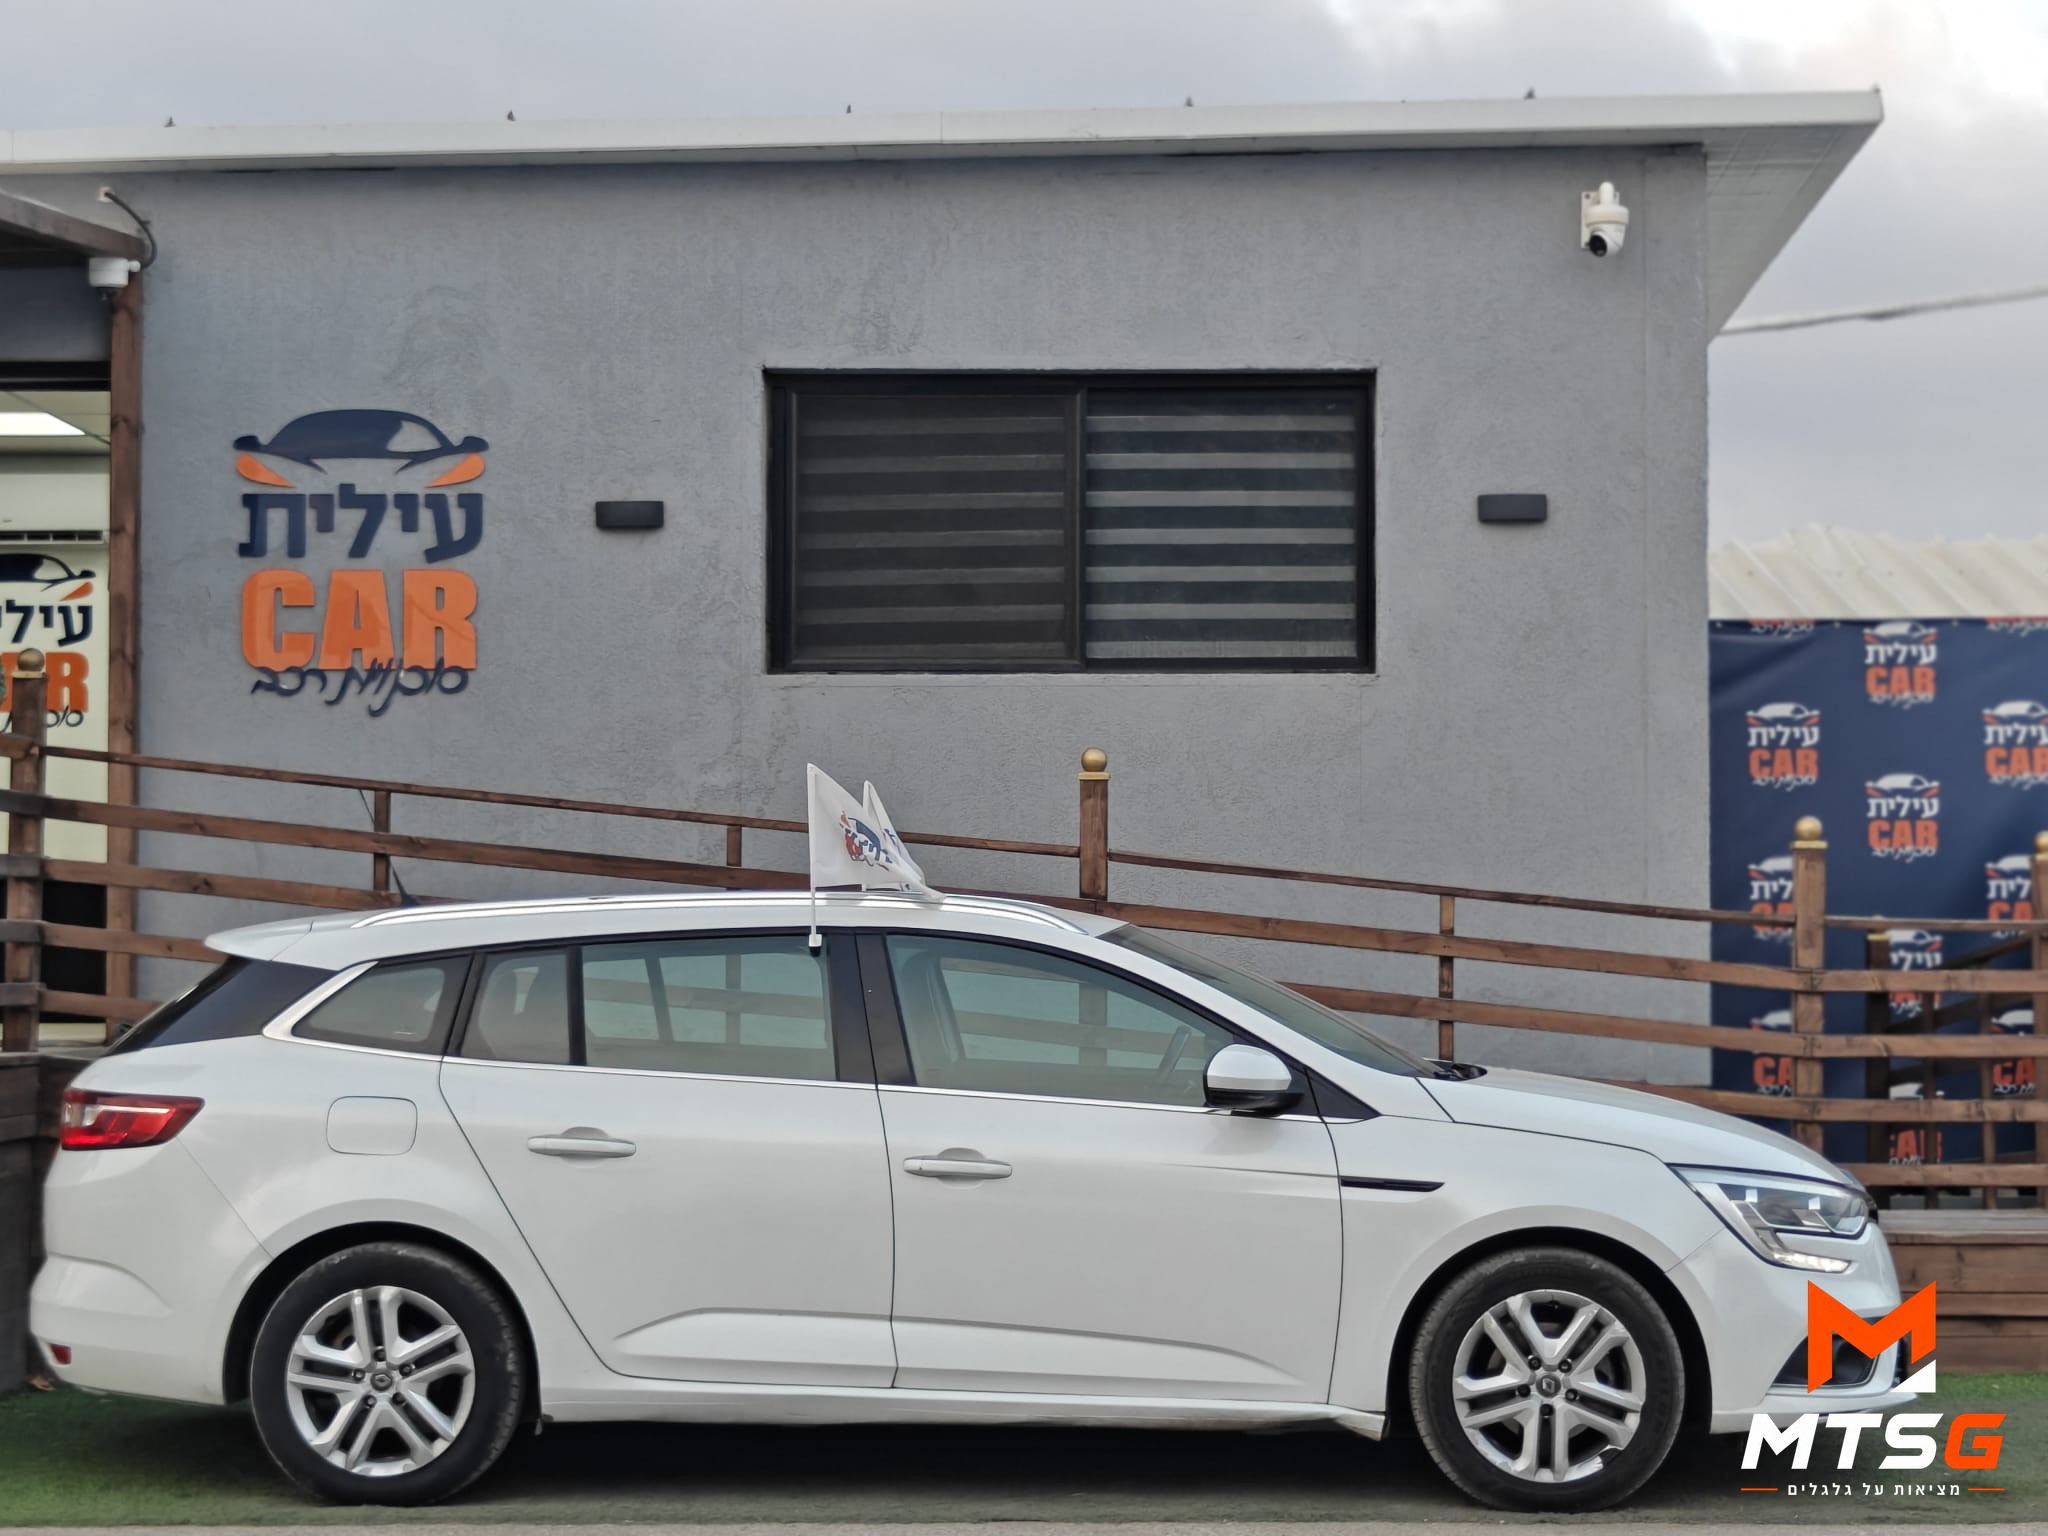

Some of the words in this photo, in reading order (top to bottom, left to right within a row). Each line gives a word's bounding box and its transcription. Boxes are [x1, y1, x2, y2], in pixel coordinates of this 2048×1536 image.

[238, 483, 483, 563] עילית
[0, 599, 93, 647] עיל
[241, 569, 477, 671] CAR
[1864, 642, 1937, 665] עילית
[1865, 665, 1936, 697] CAR
[1747, 724, 1820, 747] עילית
[1749, 748, 1819, 779] CAR
[1867, 795, 1940, 818] עילית
[1868, 819, 1938, 850] CAR
[1749, 877, 1793, 900] לית
[1987, 876, 2031, 899] לית
[1753, 1056, 1792, 1087] CA
[1992, 1056, 2035, 1086] CA
